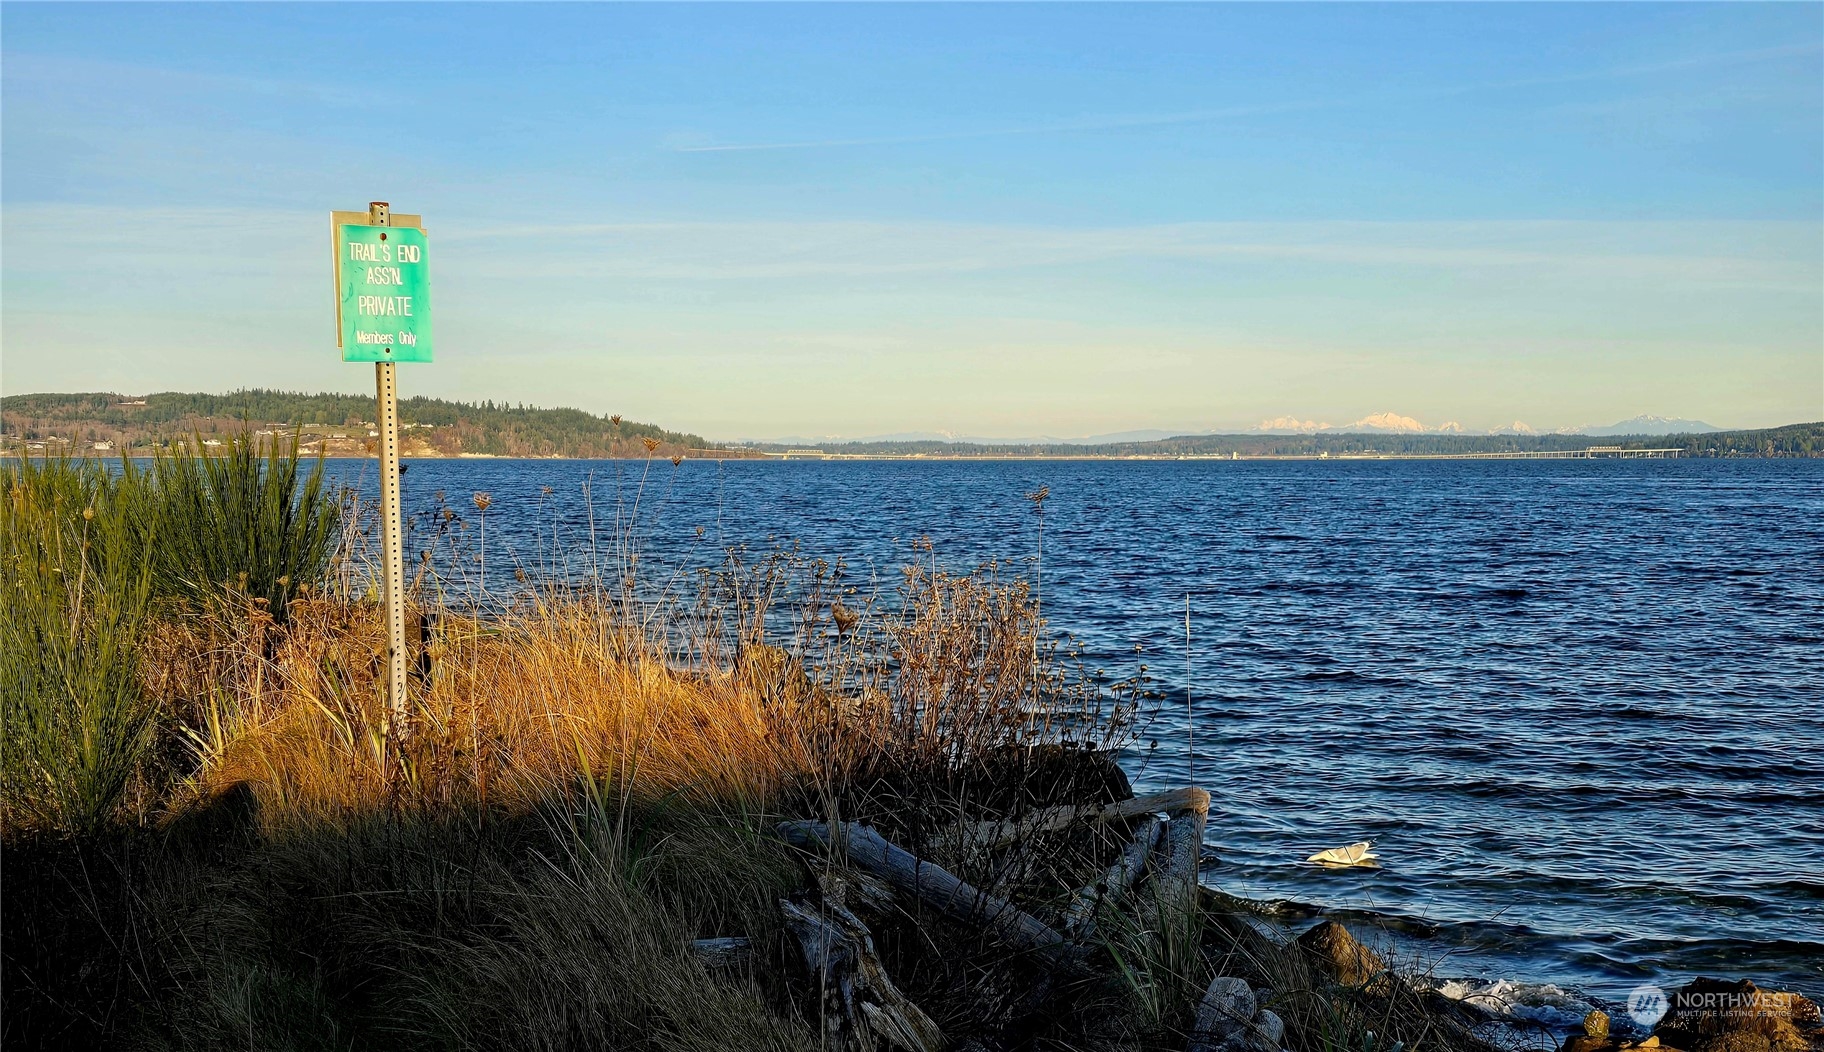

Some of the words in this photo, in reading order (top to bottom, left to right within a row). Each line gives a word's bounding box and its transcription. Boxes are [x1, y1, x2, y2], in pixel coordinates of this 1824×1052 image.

[348, 242, 391, 262] TRAIL'S
[397, 244, 420, 263] END
[358, 295, 413, 316] PRIVATE
[356, 330, 394, 345] Members
[398, 331, 417, 347] Only
